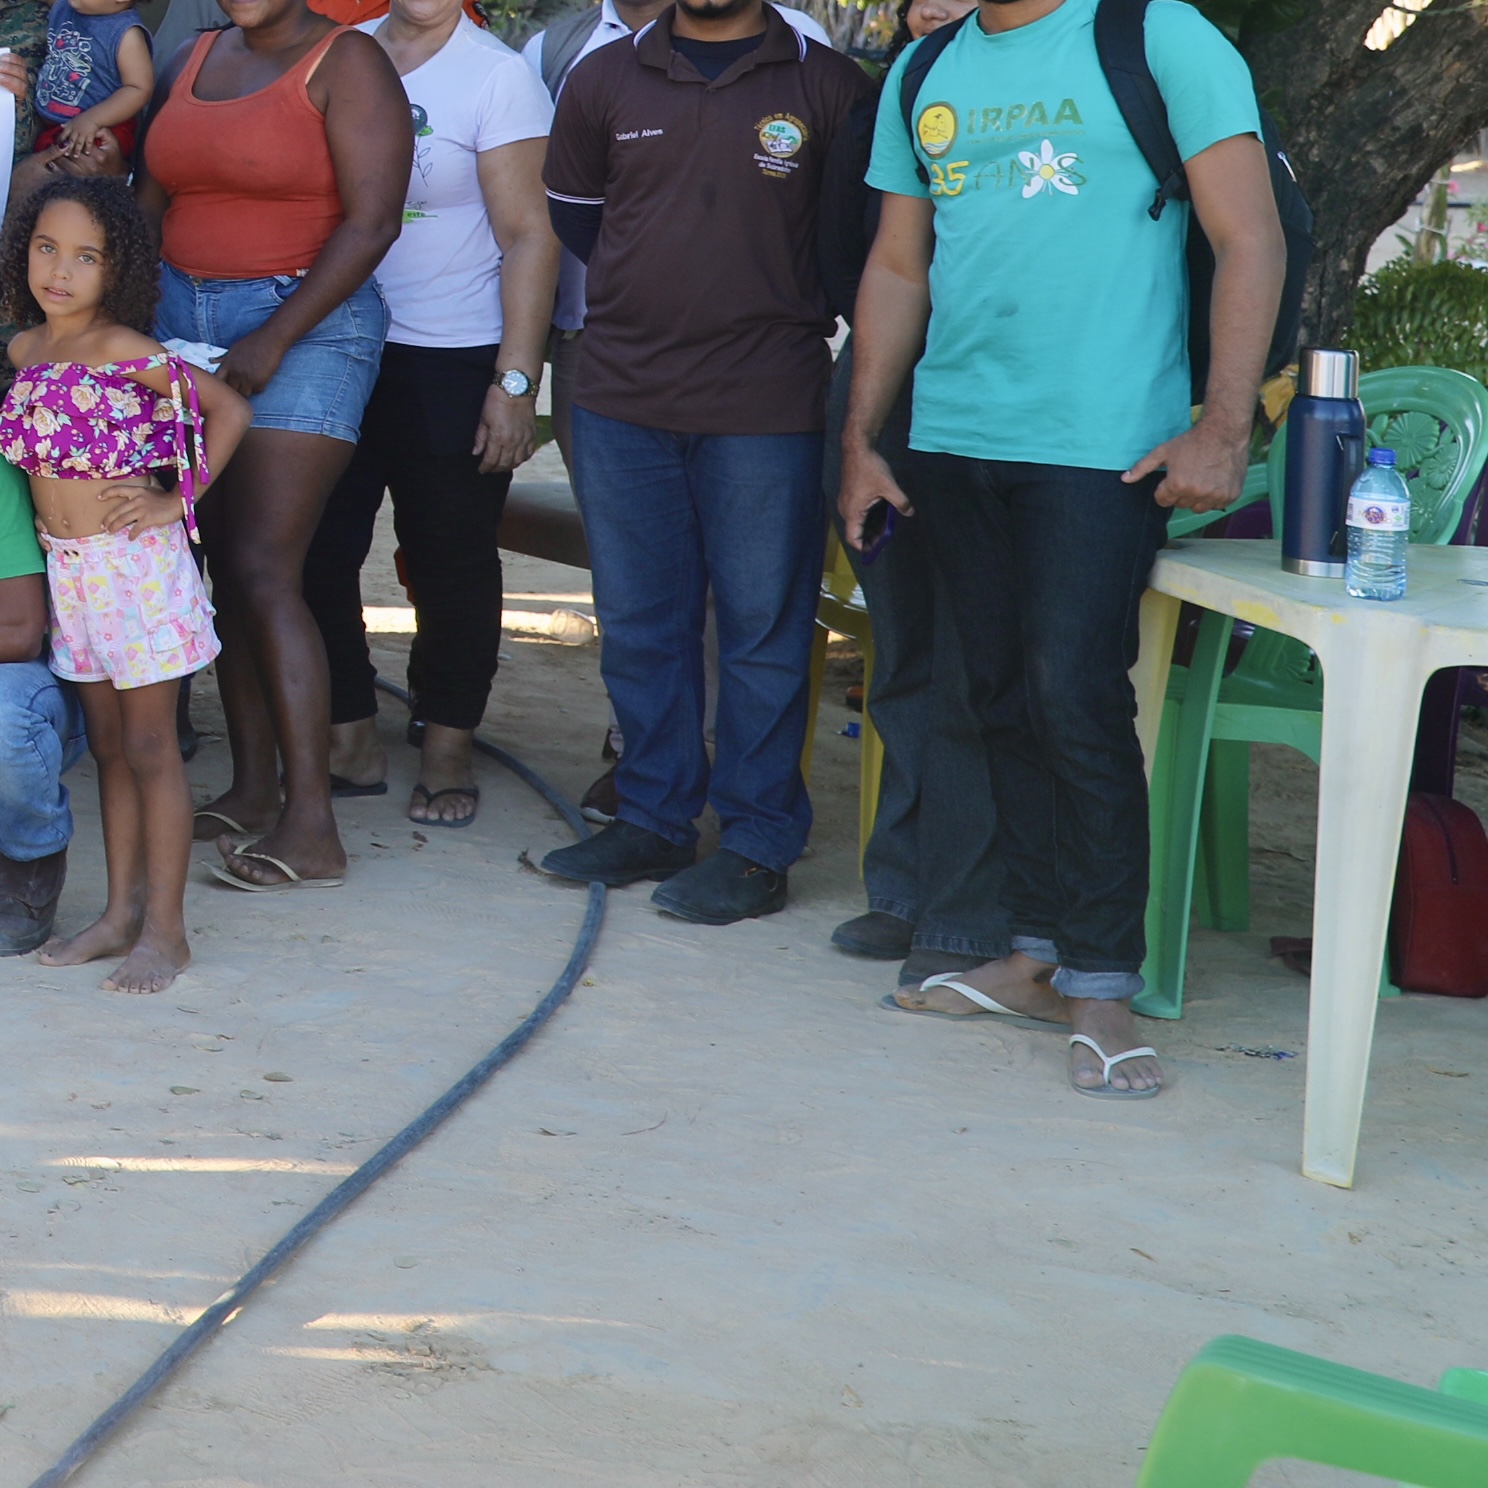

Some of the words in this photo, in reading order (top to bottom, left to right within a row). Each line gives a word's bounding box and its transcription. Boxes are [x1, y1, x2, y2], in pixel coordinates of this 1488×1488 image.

[967, 98, 1083, 134] IRPAA
[616, 129, 639, 141] Gabriel
[641, 128, 664, 138] Alves
[929, 161, 970, 196] 35
